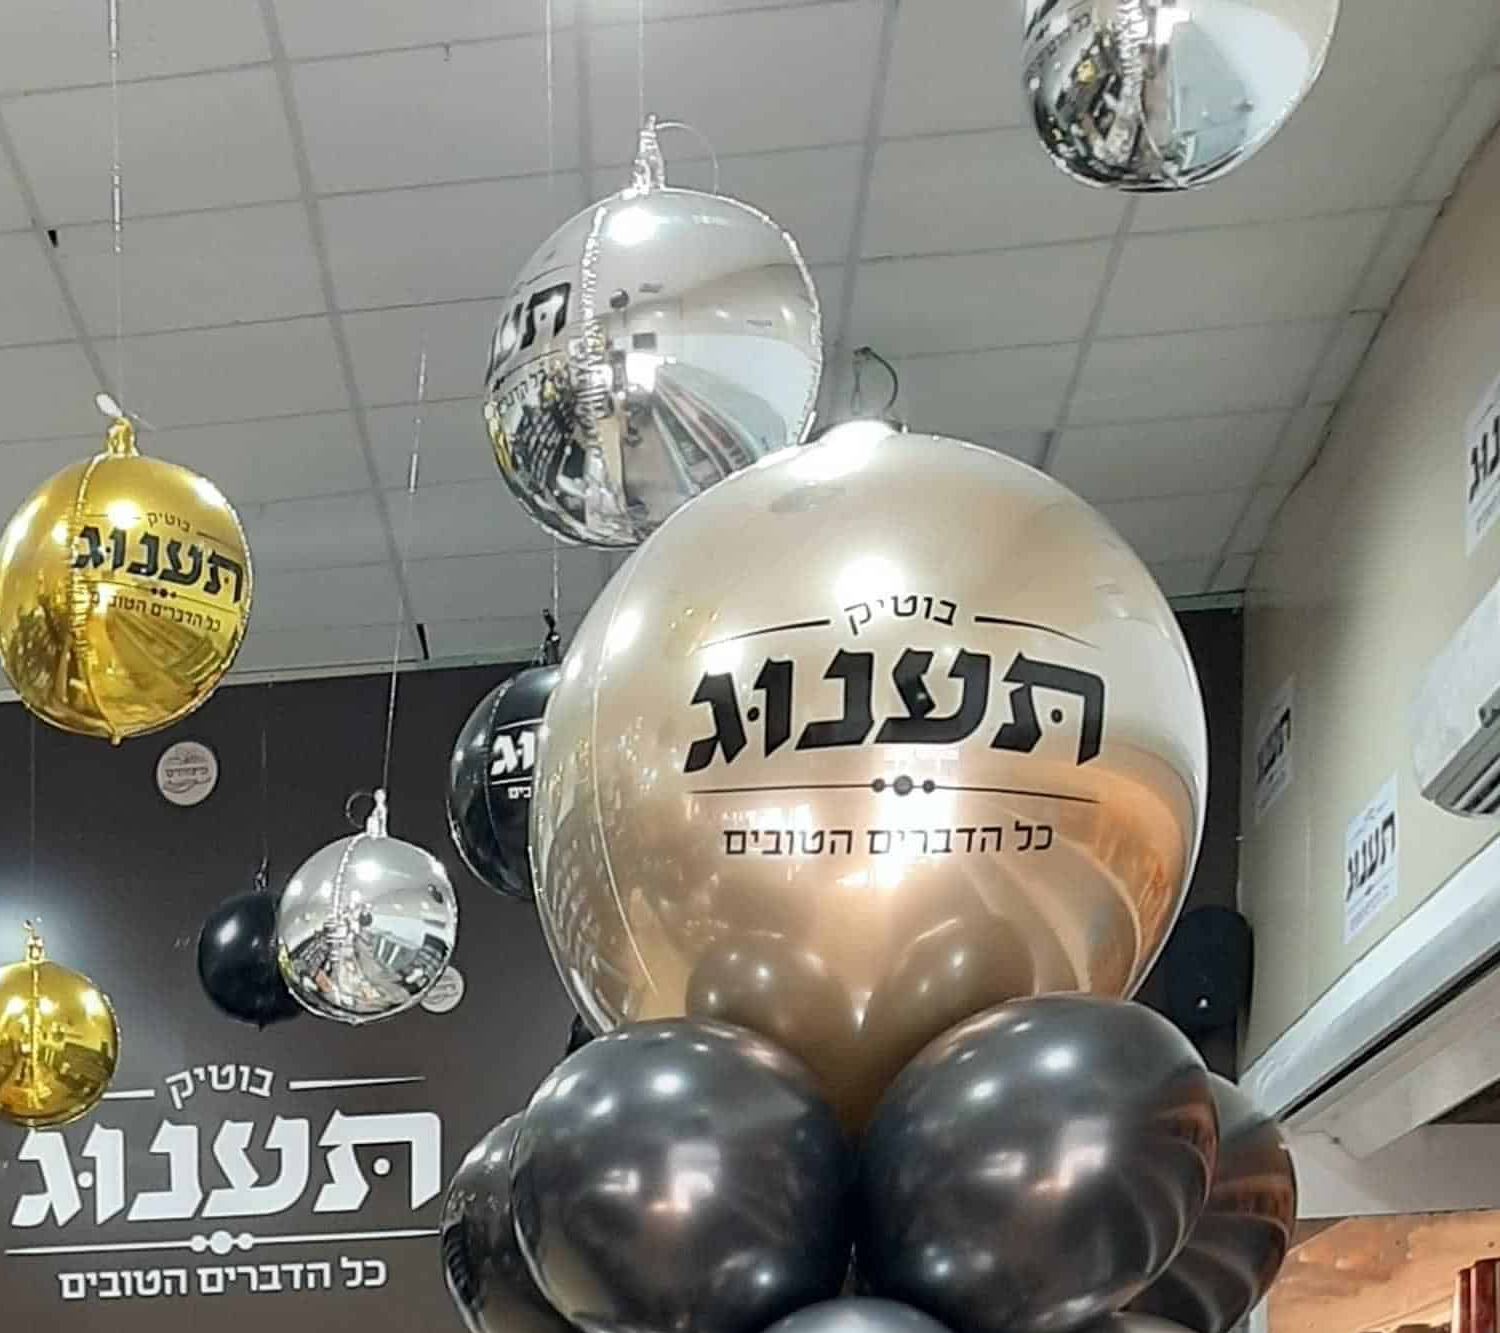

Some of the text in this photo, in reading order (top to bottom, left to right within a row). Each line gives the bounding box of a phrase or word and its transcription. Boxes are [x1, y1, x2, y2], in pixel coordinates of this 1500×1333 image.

[146, 511, 192, 533] בוטיק
[71, 525, 244, 604] תענוג
[151, 604, 203, 628] הדברים
[205, 617, 222, 634] כל
[844, 595, 958, 636] בוטיק
[683, 648, 1105, 774] תענוג
[723, 820, 1053, 856] כל הדברים הטובים
[165, 1064, 274, 1110] בוטיק
[11, 1108, 441, 1227] תענוג
[58, 1256, 388, 1300] כל הדברים הטובים
